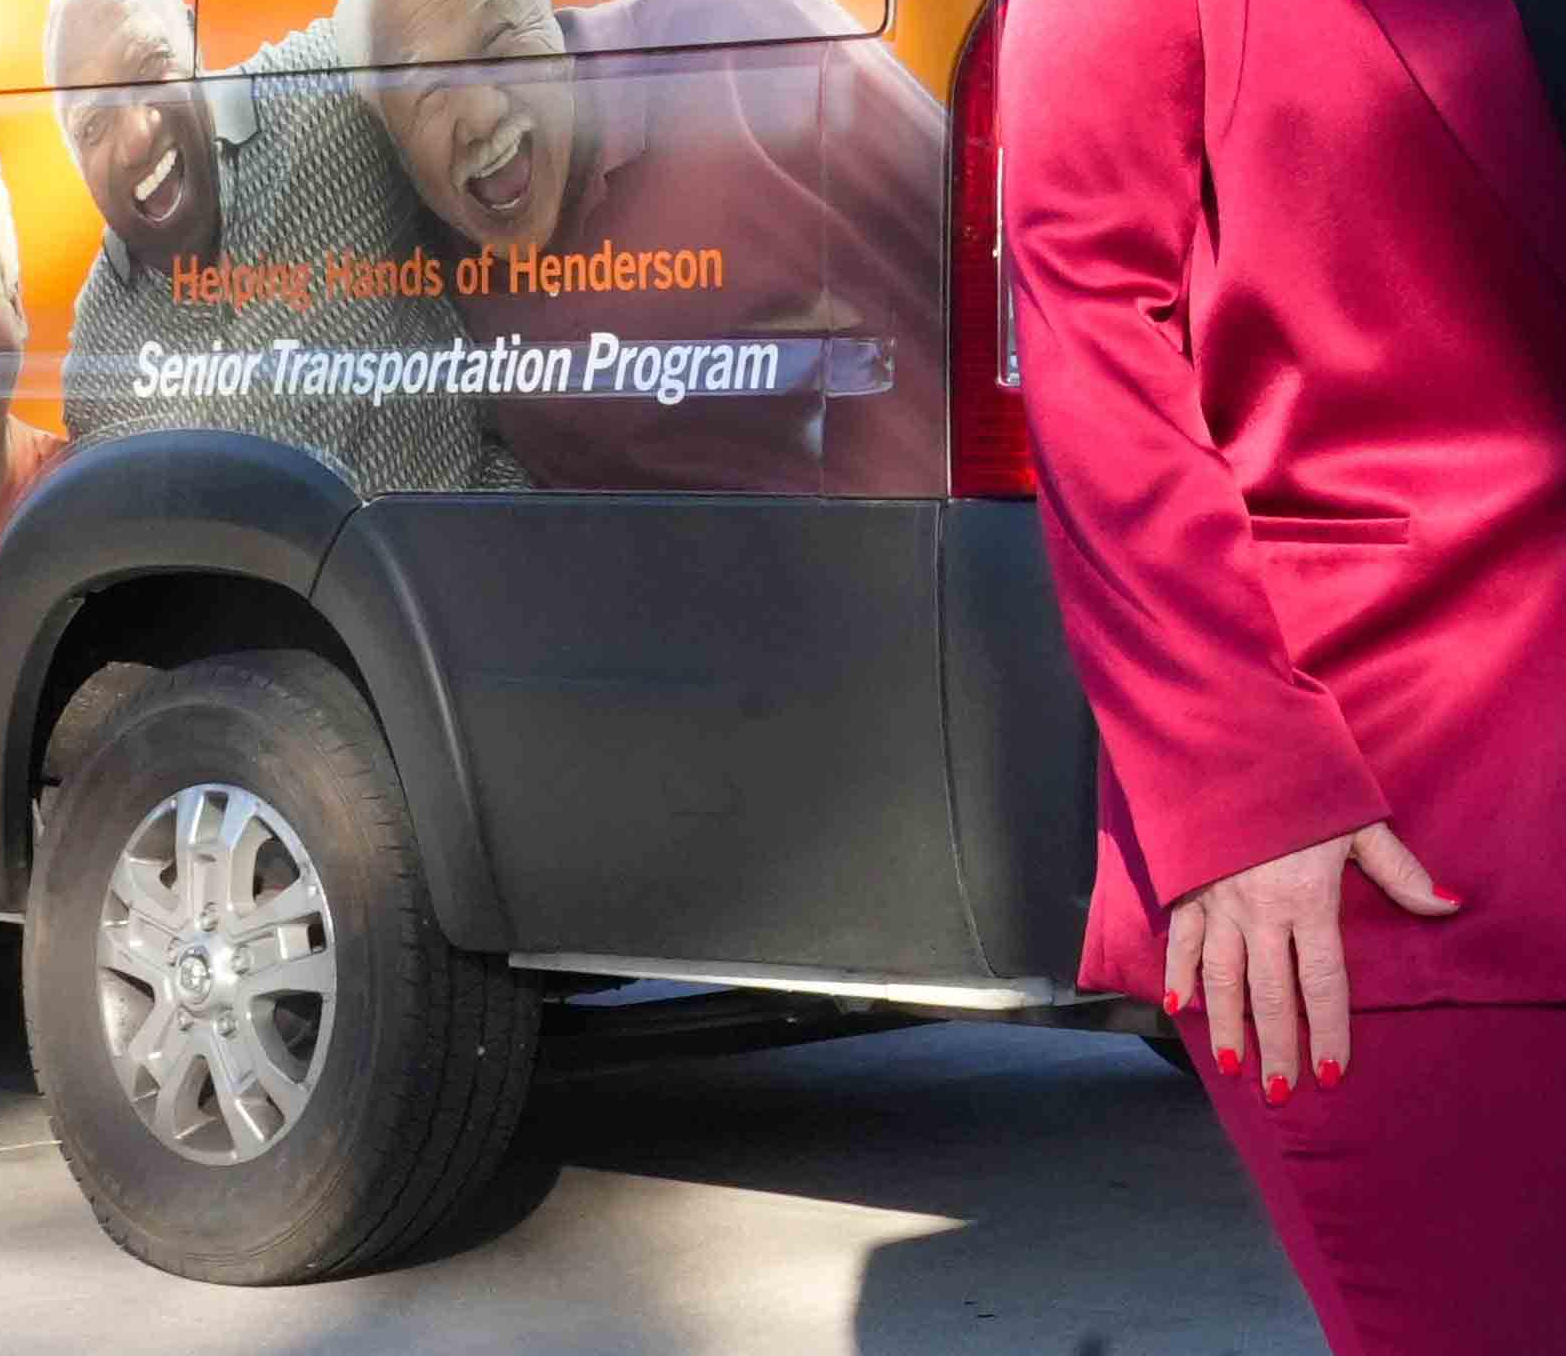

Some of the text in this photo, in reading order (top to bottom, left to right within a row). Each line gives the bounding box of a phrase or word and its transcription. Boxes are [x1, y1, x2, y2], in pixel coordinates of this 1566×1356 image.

[172, 238, 725, 311] Helping Hands of Henderson
[134, 331, 779, 407] Senior Transportation Program
